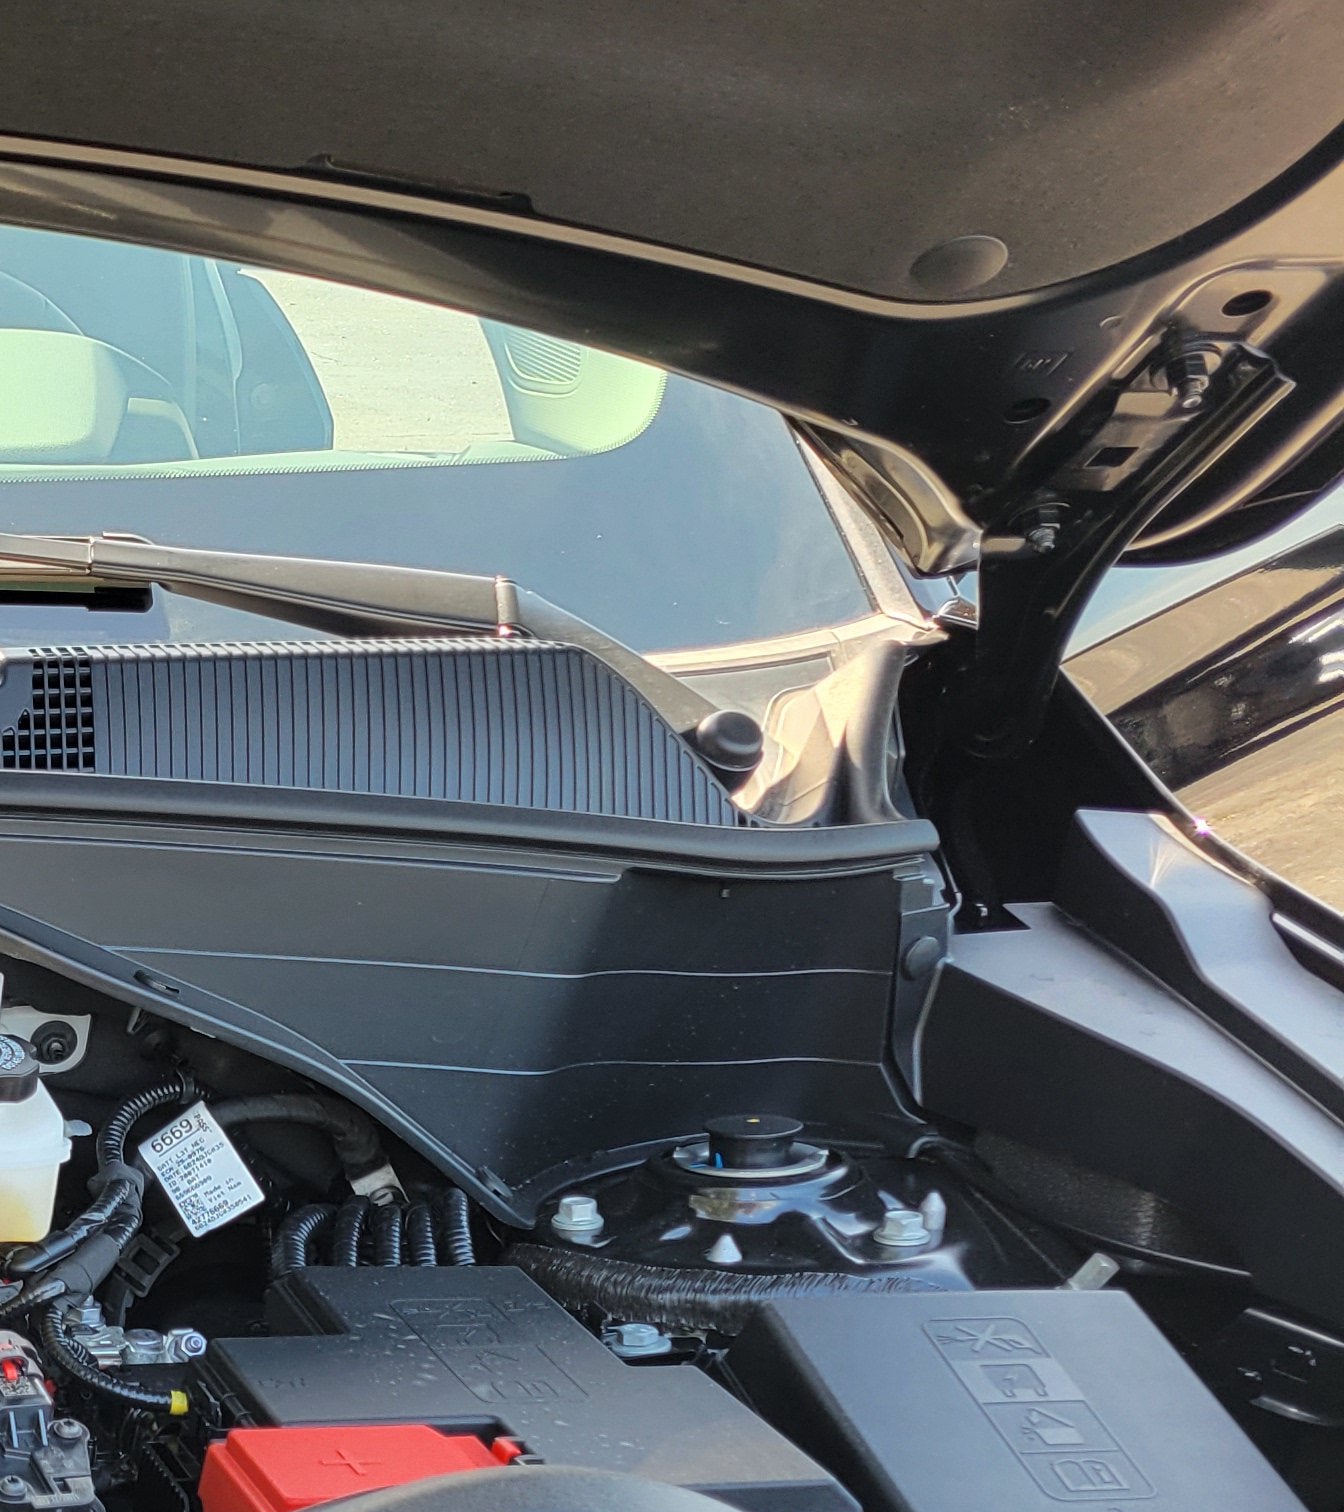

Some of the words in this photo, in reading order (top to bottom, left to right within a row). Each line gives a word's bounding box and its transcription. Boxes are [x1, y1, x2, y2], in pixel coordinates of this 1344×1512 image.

[151, 1119, 192, 1153] 6669
[204, 1184, 220, 1196] Made
[208, 1191, 224, 1202] Viet
[227, 1180, 240, 1190] Nam
